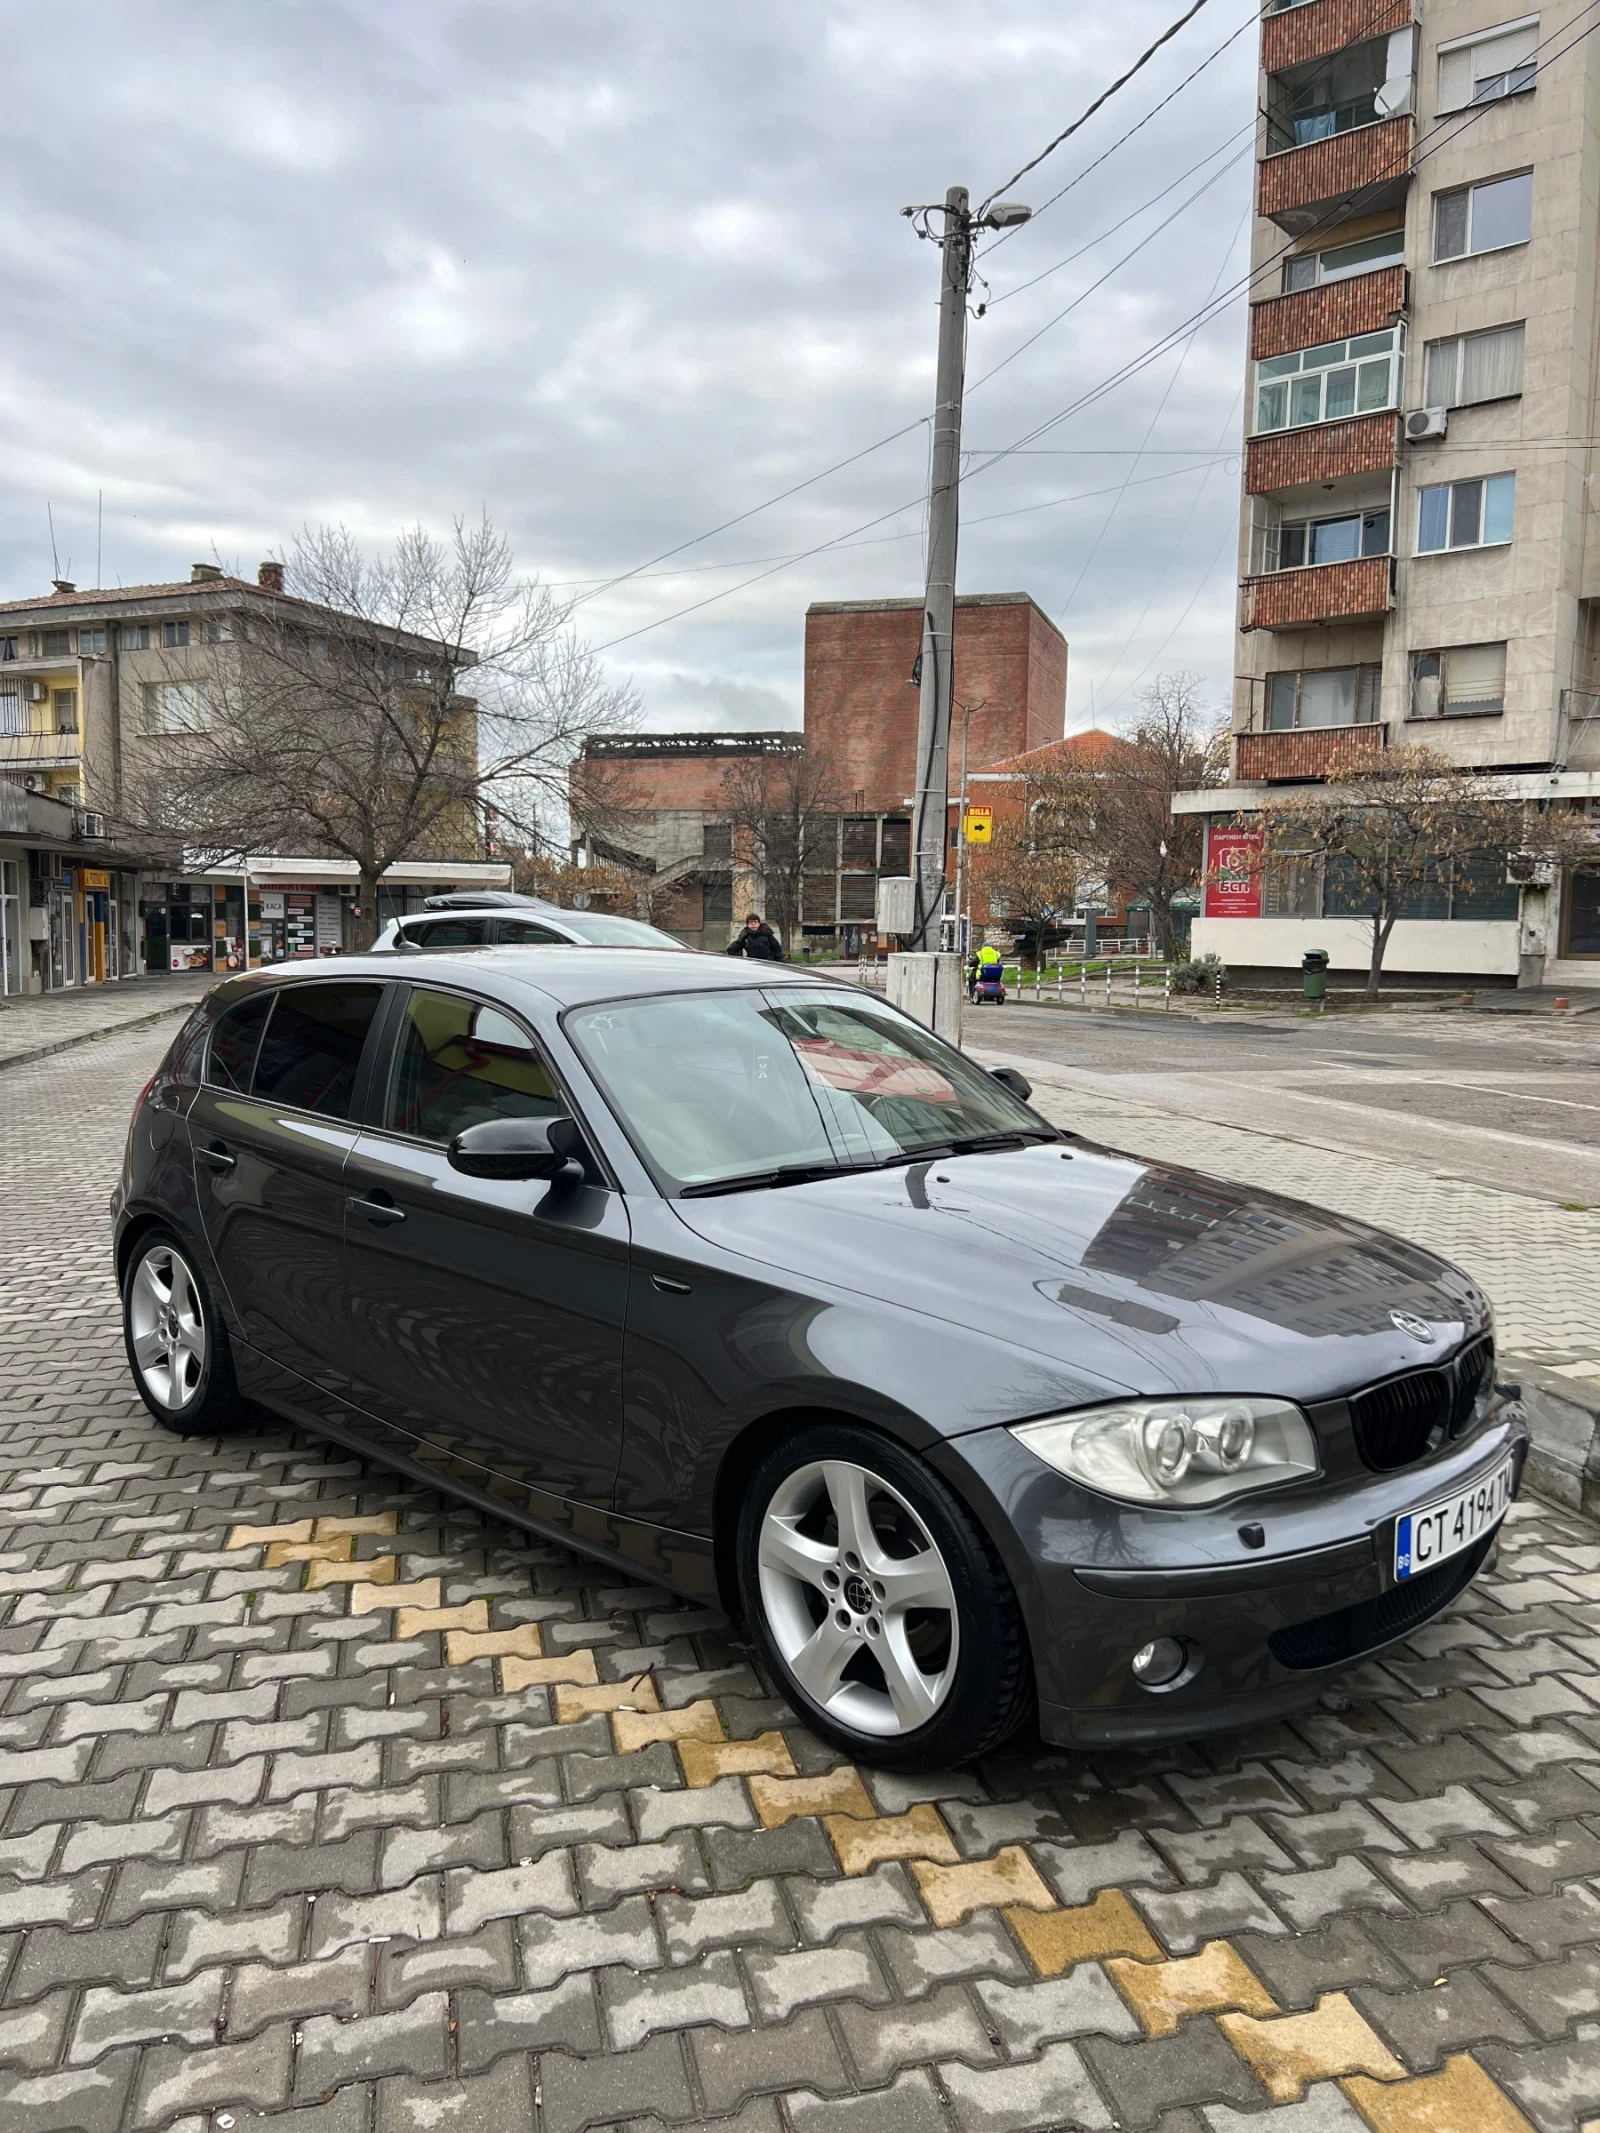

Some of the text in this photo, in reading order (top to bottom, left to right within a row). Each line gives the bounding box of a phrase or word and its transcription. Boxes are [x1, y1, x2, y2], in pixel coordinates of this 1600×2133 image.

[1219, 881, 1250, 893] БСП
[1416, 1508, 1448, 1562] CT
[1453, 1478, 1494, 1541] 4194
[1397, 1553, 1410, 1570] BG
